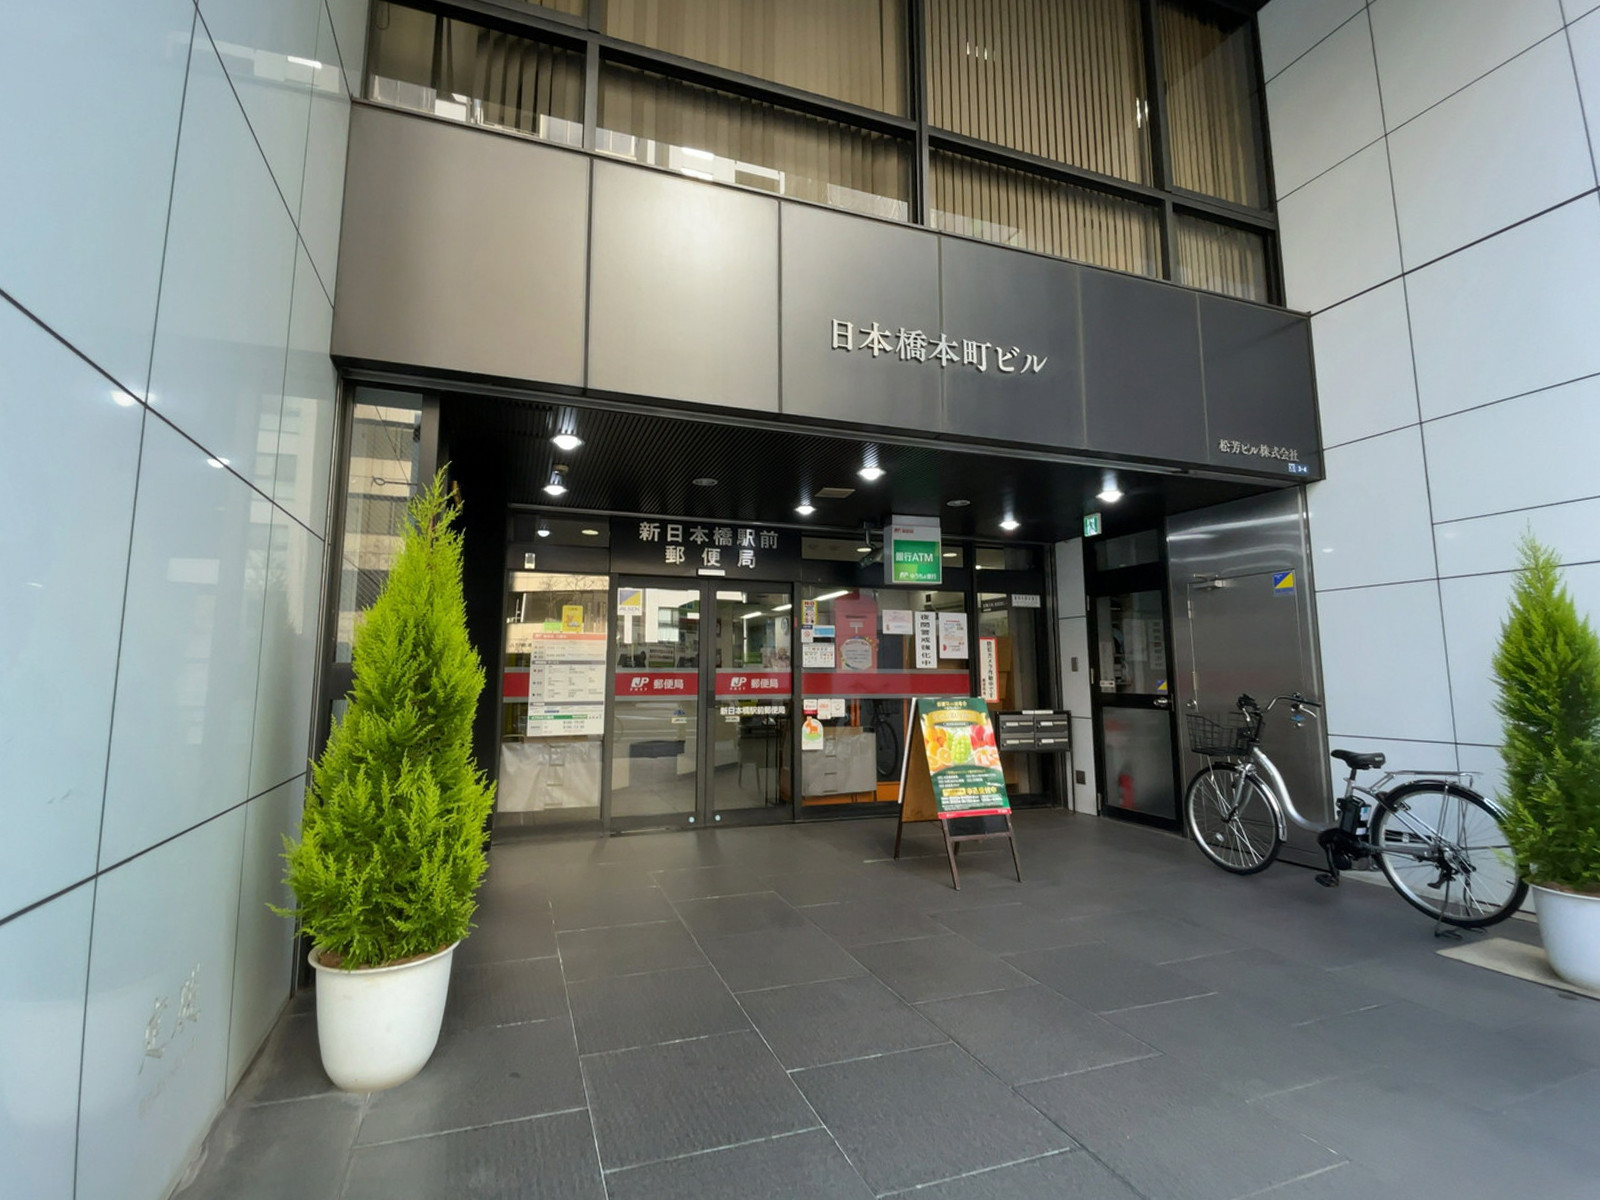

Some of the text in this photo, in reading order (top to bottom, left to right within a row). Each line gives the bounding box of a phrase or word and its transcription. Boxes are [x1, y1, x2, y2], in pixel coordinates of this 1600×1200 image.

[832, 318, 1048, 374] 日本橋本町ビル
[1219, 439, 1299, 462] 松芳ビル株式会社
[639, 521, 778, 549] 新日本橋駅前
[665, 545, 756, 569] 郵便局
[895, 552, 933, 562] 銀行ATM
[653, 678, 684, 690] 郵便局
[751, 678, 778, 689] 郵便局
